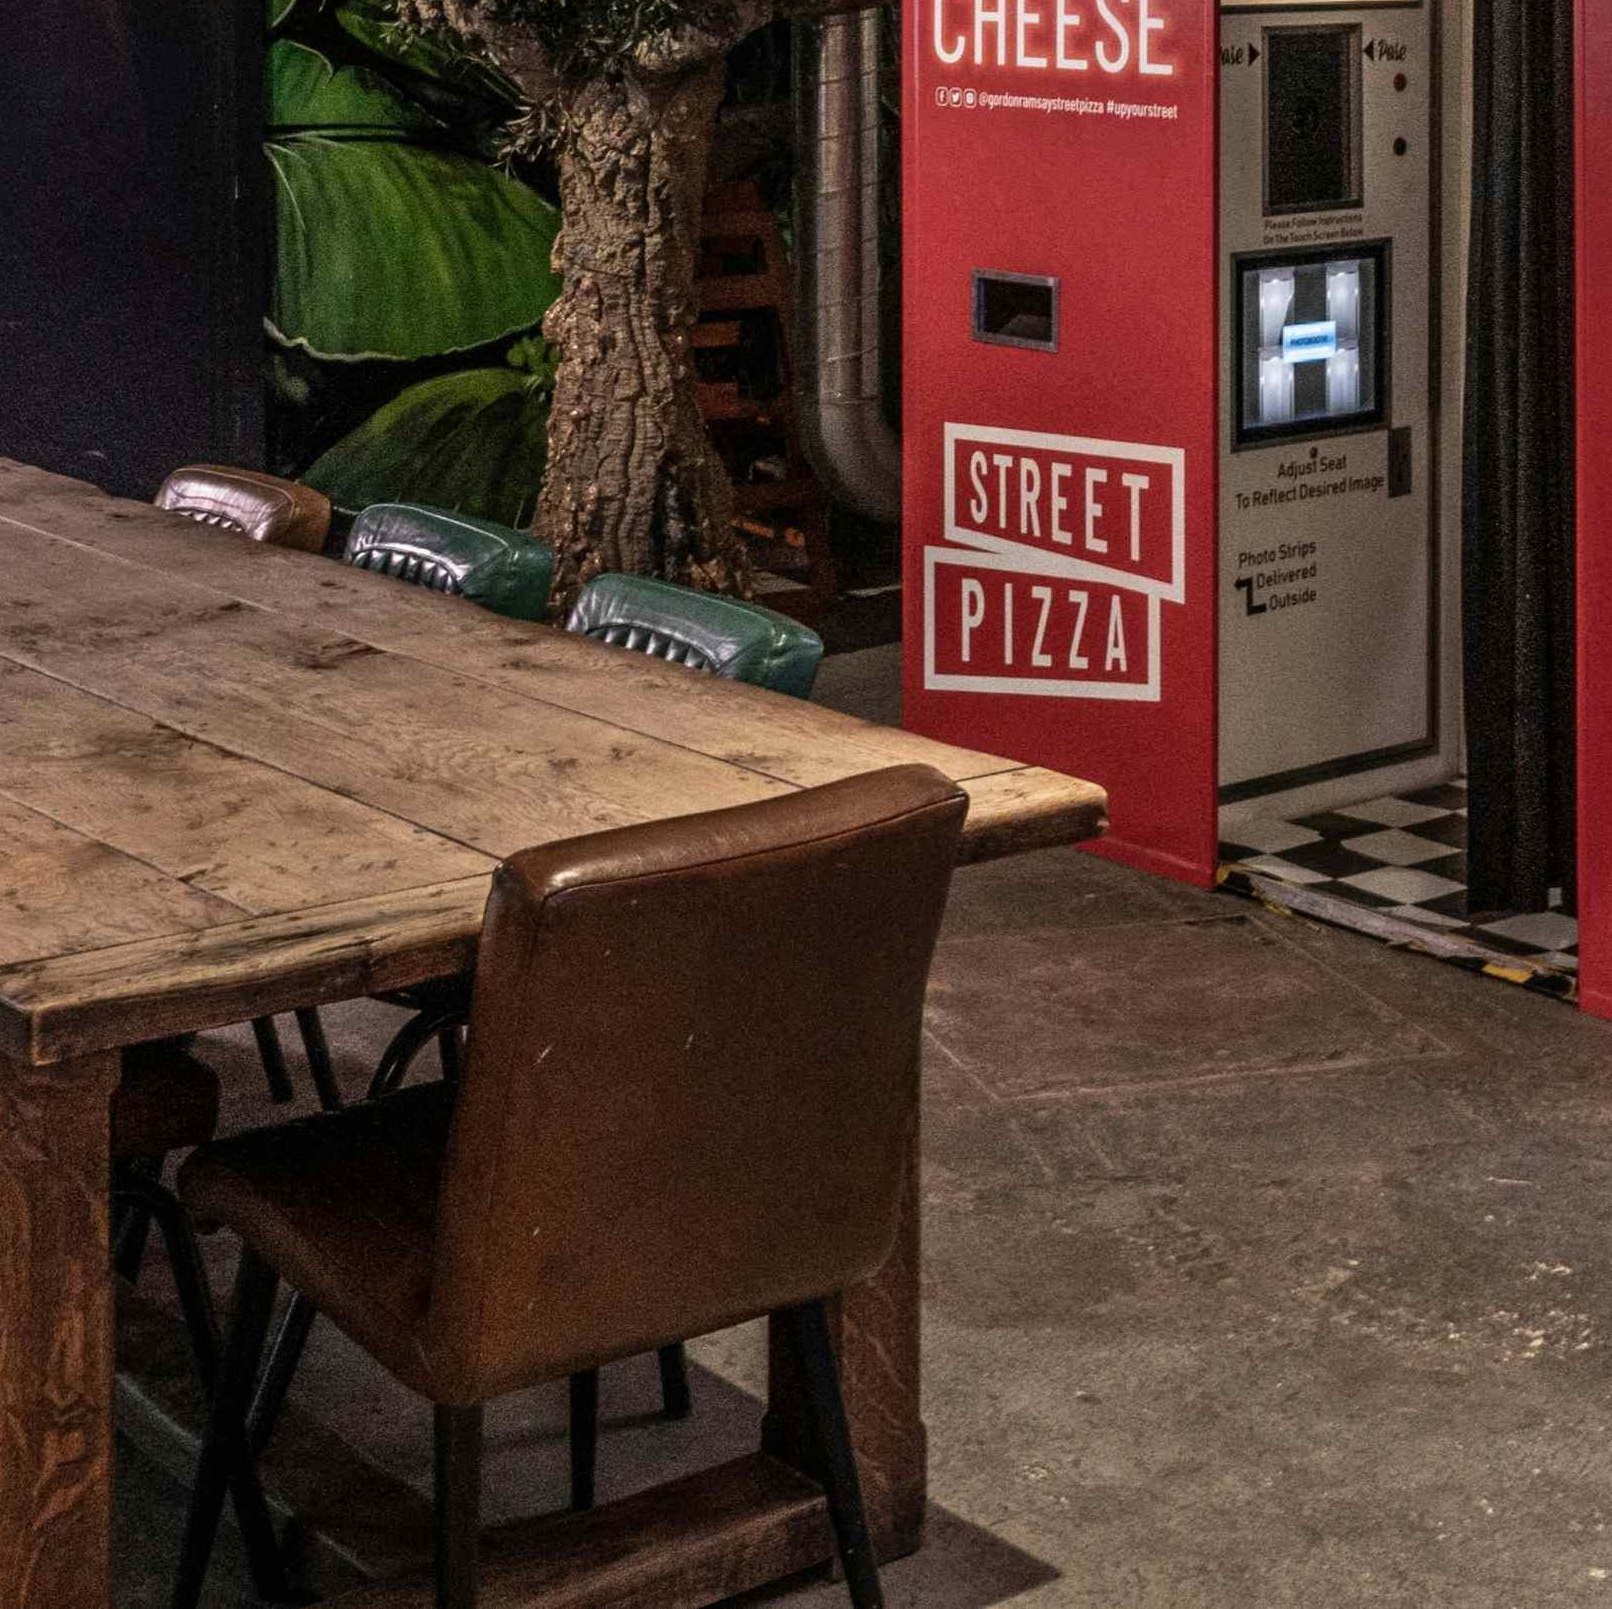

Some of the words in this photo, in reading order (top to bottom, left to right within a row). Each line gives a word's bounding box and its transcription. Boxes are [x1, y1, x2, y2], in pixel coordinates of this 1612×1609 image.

[1219, 46, 1244, 66] ose
[979, 91, 1104, 115] @gordonramsaystreetpizza
[1106, 100, 1178, 120] #upyourstreet
[1277, 459, 1317, 480] Adjust
[1320, 454, 1347, 472] Seat
[970, 450, 1150, 561] STREET
[1235, 492, 1250, 510] To
[1253, 486, 1297, 507] Reflect
[1299, 477, 1346, 500] Desired
[1348, 475, 1385, 492] Image
[1238, 546, 1276, 569] Photo
[1278, 541, 1317, 561] Strips
[1256, 562, 1317, 589] Delivered
[1268, 587, 1317, 612] Outside
[961, 577, 1127, 672] PIZZA
